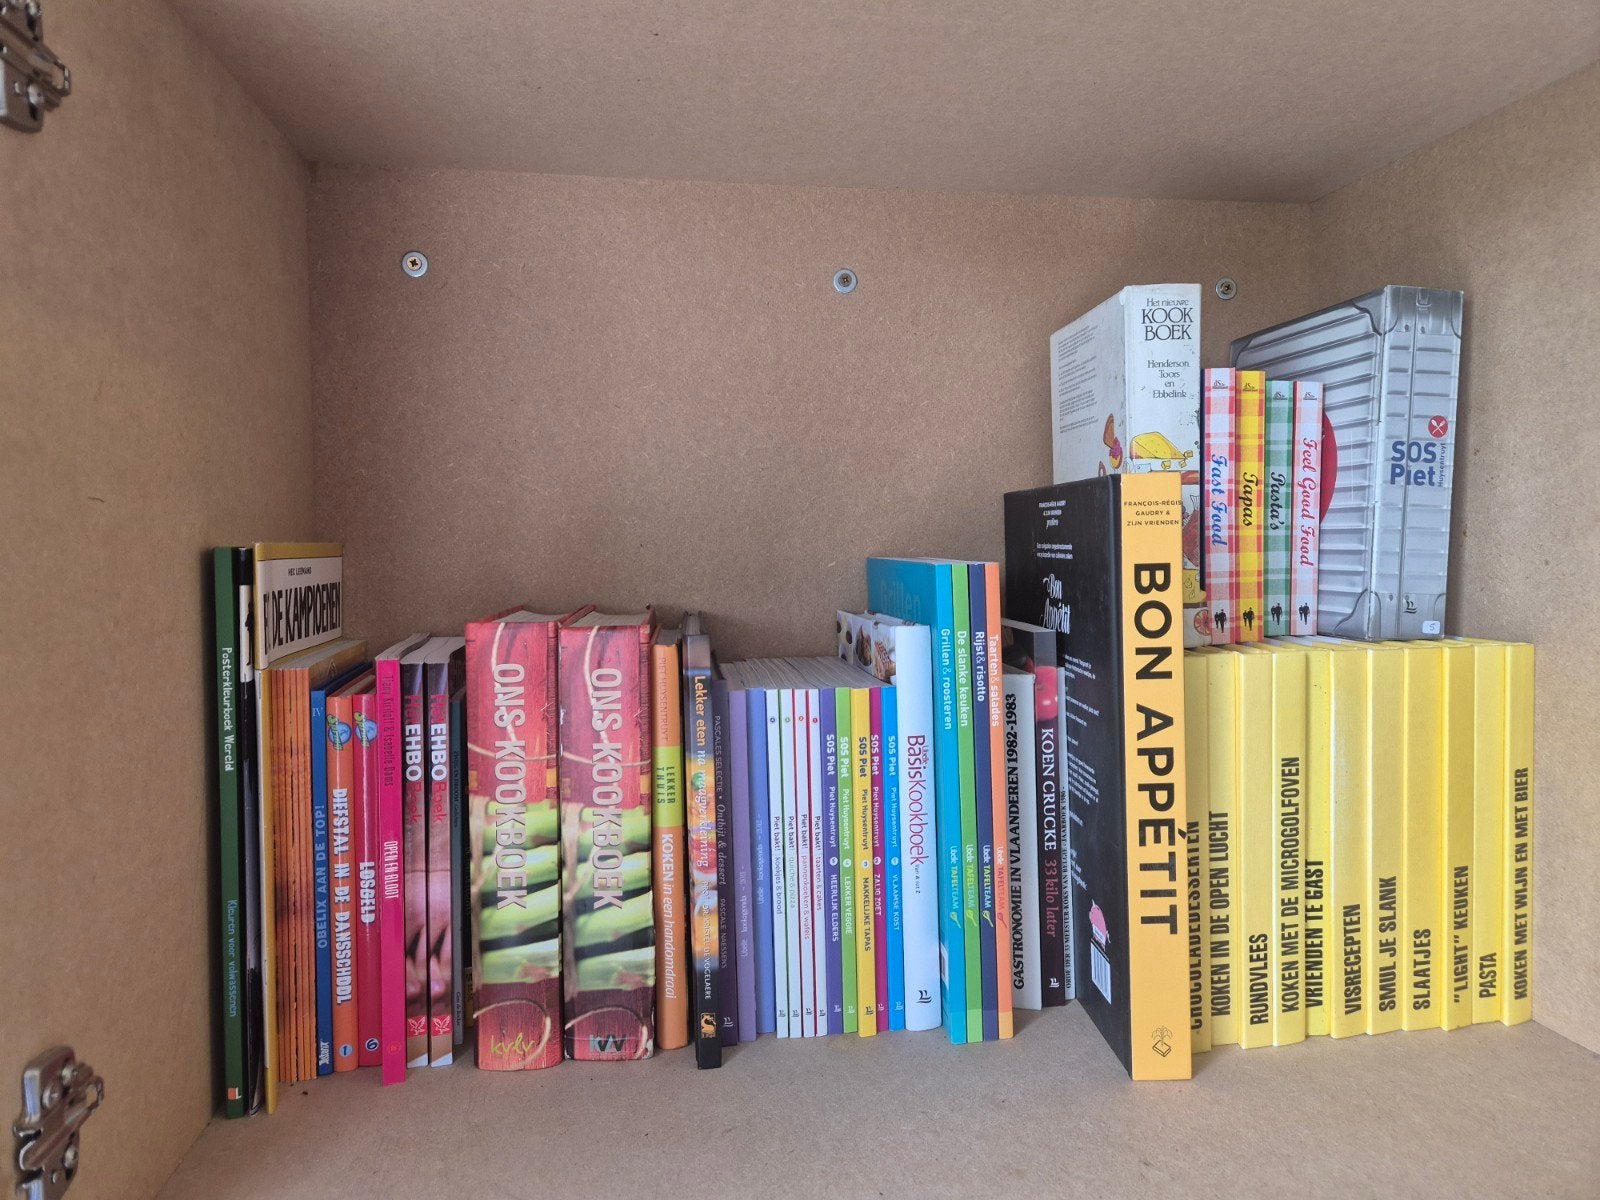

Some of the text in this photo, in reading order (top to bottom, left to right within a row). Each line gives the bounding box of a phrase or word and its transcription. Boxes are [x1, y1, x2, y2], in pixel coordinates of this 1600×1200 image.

[1141, 307, 1194, 324] KOOK
[1144, 325, 1192, 341] BOEK
[1146, 298, 1160, 306] Het
[1152, 390, 1187, 398] Ebbelink
[1158, 370, 1180, 378] Toors
[1390, 441, 1437, 463] SOS
[1390, 463, 1436, 487] Piet
[1438, 443, 1447, 487] Huysentruyt
[1123, 499, 1182, 507] FRANÇOIS-RÉGIS
[1211, 454, 1228, 546] Fast Food
[1237, 472, 1259, 527] Tapas
[1269, 472, 1287, 531] Pasta's
[1299, 438, 1318, 566] Feel Good Food
[271, 581, 341, 650] DE KAMPIOENEN
[941, 628, 952, 730] Grillen roosteren
[956, 630, 969, 727] De slanke keuken
[973, 631, 987, 702] Rijst risotto
[988, 635, 1001, 727] Taarten salades
[222, 647, 235, 772] Posterkleurboek Wereld
[660, 678, 669, 742] HUYSENTRUYT
[383, 734, 395, 786] Isabelle Dams
[694, 676, 715, 867] Lekker eten na maagverkleining
[826, 734, 836, 776] SOS Piet
[840, 736, 850, 777] SOS Piet
[858, 737, 868, 777] SOS Piet
[870, 735, 880, 776] SOS Piet
[888, 736, 897, 776] SOS Piet
[1134, 563, 1187, 935] BON APPÉTIT
[493, 664, 527, 910] ONS KOOKBOEK
[591, 668, 623, 910] ONS KOOKBOEK
[656, 767, 666, 804] THUIS
[666, 766, 676, 804] LEKKER
[714, 715, 727, 885] PASCALES SELECTIE Ontbijt dessert
[842, 789, 850, 803] Piet
[890, 787, 898, 801] Piet
[907, 735, 929, 866] BasisKookboek
[828, 786, 837, 848] Piet Huysentruyt
[843, 805, 851, 850] Huysentruyt
[861, 789, 870, 851] Piet Huysentruyt
[872, 787, 881, 848] Piet Huysentruyt
[890, 803, 899, 848] Huysentruyt
[1005, 694, 1025, 990] GASTRONOMIE IN VLAANDEREN 1982-1983
[1041, 728, 1059, 938] KOEN CRUCKE 33 kilo later
[314, 804, 329, 949] OBELIX AAN DE TOP!
[332, 788, 352, 1006] DIEFSTAL IN DE DANSSCHOOL
[359, 862, 376, 924] LOSGELD
[383, 840, 399, 899] OPEN BLOOT
[801, 855, 810, 908] pannenkoeken
[844, 876, 853, 906] LEKKER
[892, 875, 900, 910] VLAAMSE
[950, 866, 960, 910] TAFELTEAM
[966, 864, 975, 908] TAFELTEAM
[983, 865, 993, 909] TAFELTEAM
[997, 867, 1006, 911] TAFELTEAM
[1280, 757, 1300, 1014] KOKEN MET DE MICROGOLFOVEN
[1453, 865, 1469, 931] KEUKEN
[1513, 767, 1529, 1001] KOKEN MET WIJN EN MET BIER
[662, 834, 677, 999] KOKEN in een handomdraai
[719, 898, 728, 969] PASCALE NAESSENS
[830, 874, 840, 942] HEERLIJK ELDERS
[845, 907, 853, 934] VEGGIE
[863, 877, 872, 952] MAKKELIJKE TAPAS
[1208, 811, 1231, 1017] KOKEN IN DE OPEN LUCHT
[1304, 858, 1324, 1009] VRIENDEN TE GAST
[227, 899, 238, 1017] Kleuren volwassenen
[1342, 904, 1362, 1016] VISRECEPTEN
[1378, 875, 1397, 1012] SMUL JE SLANK
[1412, 928, 1432, 1011] SLAATJES
[1248, 933, 1269, 1026] RUNDVLEES
[1478, 952, 1497, 999] PASTA
